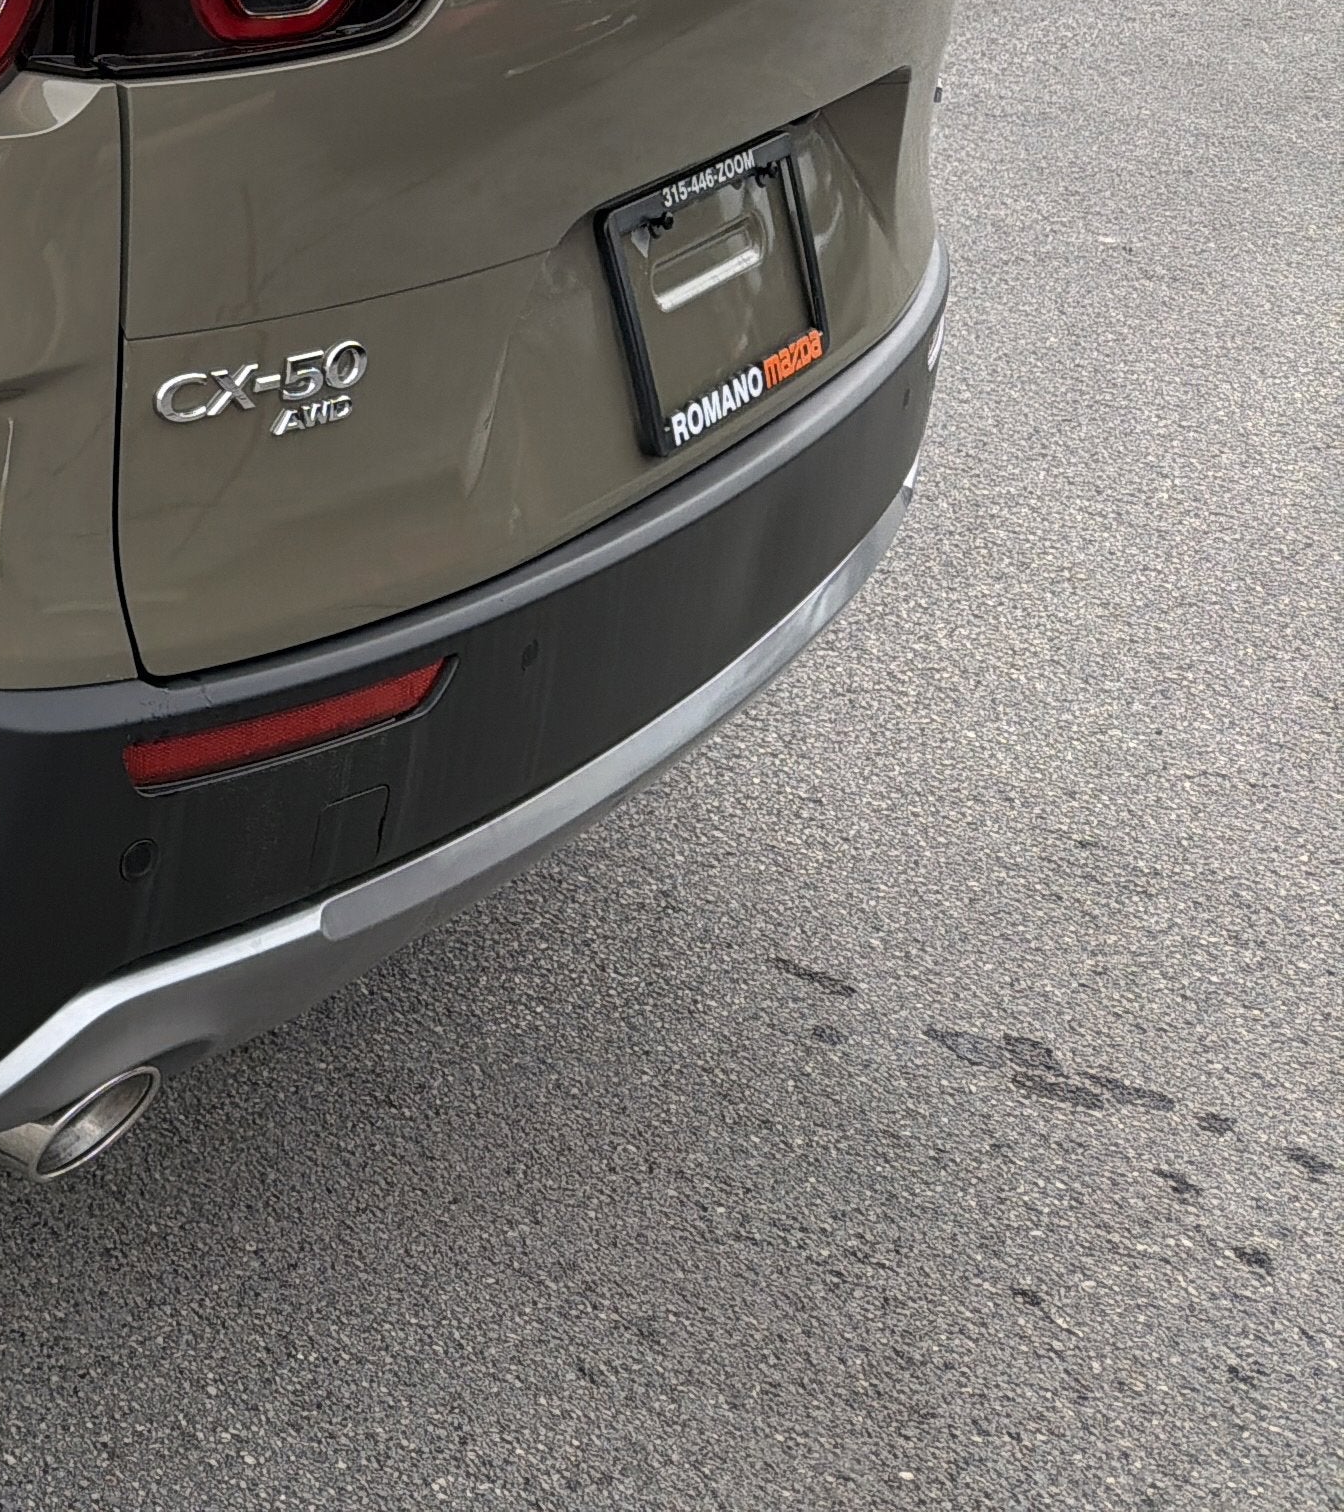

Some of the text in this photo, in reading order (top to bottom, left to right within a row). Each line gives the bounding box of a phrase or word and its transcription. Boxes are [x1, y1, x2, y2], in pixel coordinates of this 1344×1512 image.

[662, 148, 756, 208] 315-446-ZOOM
[153, 340, 368, 423] CX-50
[270, 394, 353, 436] AWD
[671, 329, 823, 447] ROMANO mazda
